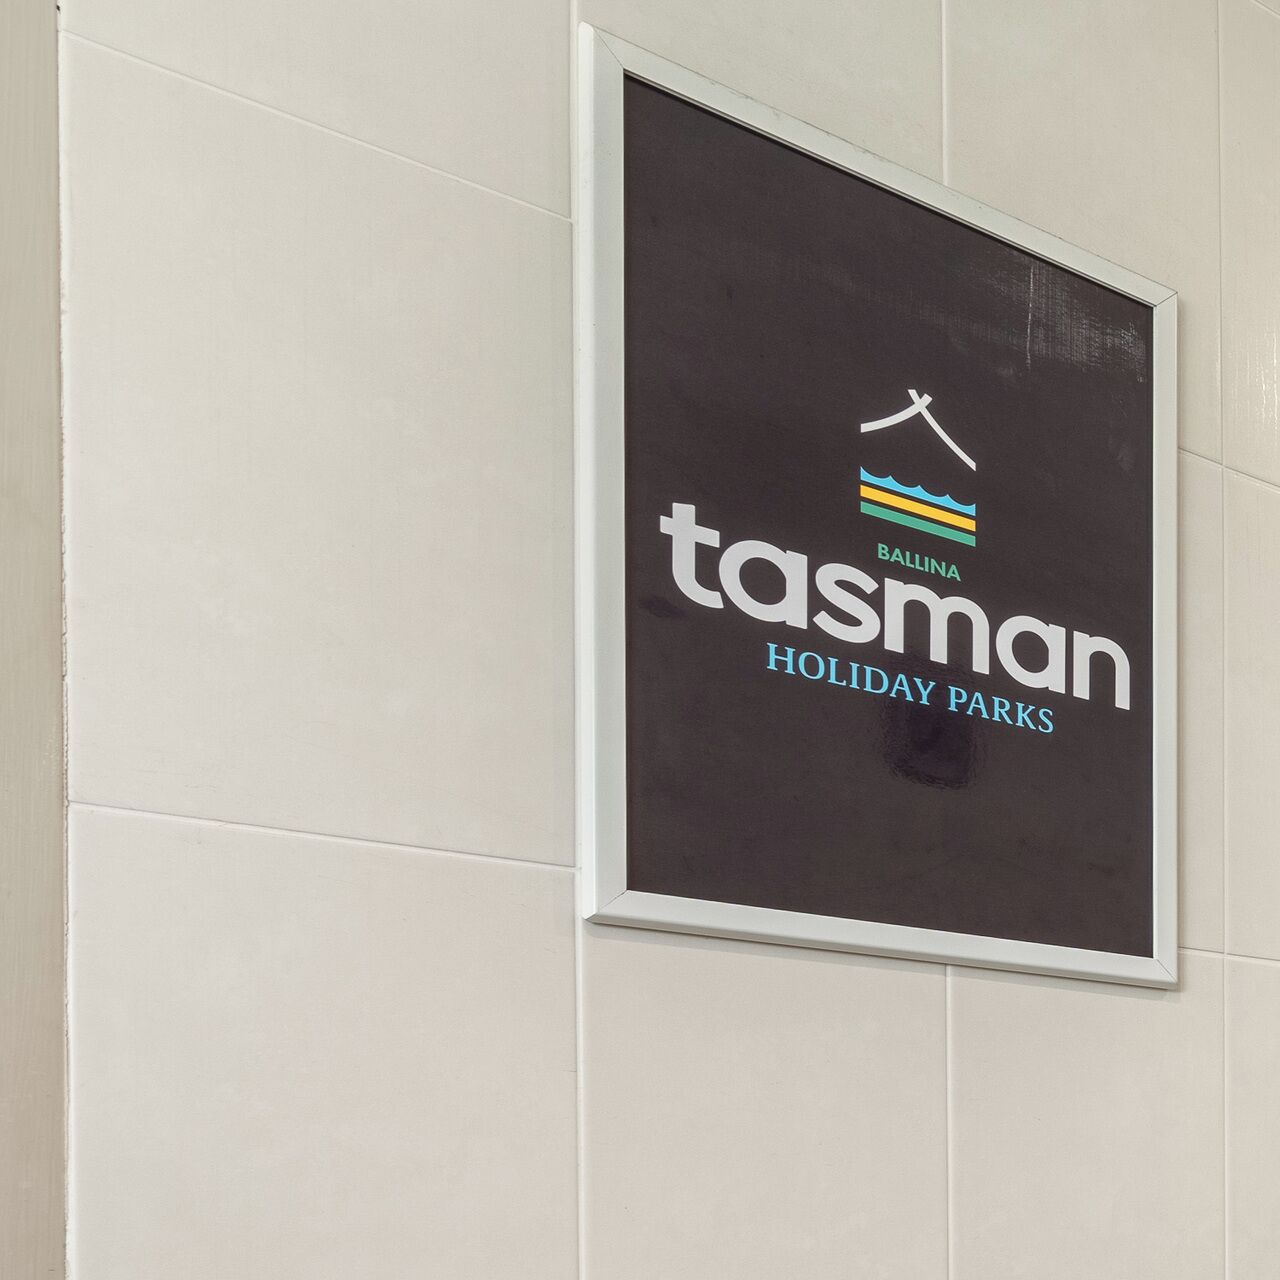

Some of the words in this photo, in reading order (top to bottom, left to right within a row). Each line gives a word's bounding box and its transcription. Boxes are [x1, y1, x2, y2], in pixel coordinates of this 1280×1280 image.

[660, 502, 1130, 710] tasman
[878, 543, 961, 581] BALLINA
[766, 642, 936, 705] HOLIDAY
[948, 686, 1054, 733] PARKS
